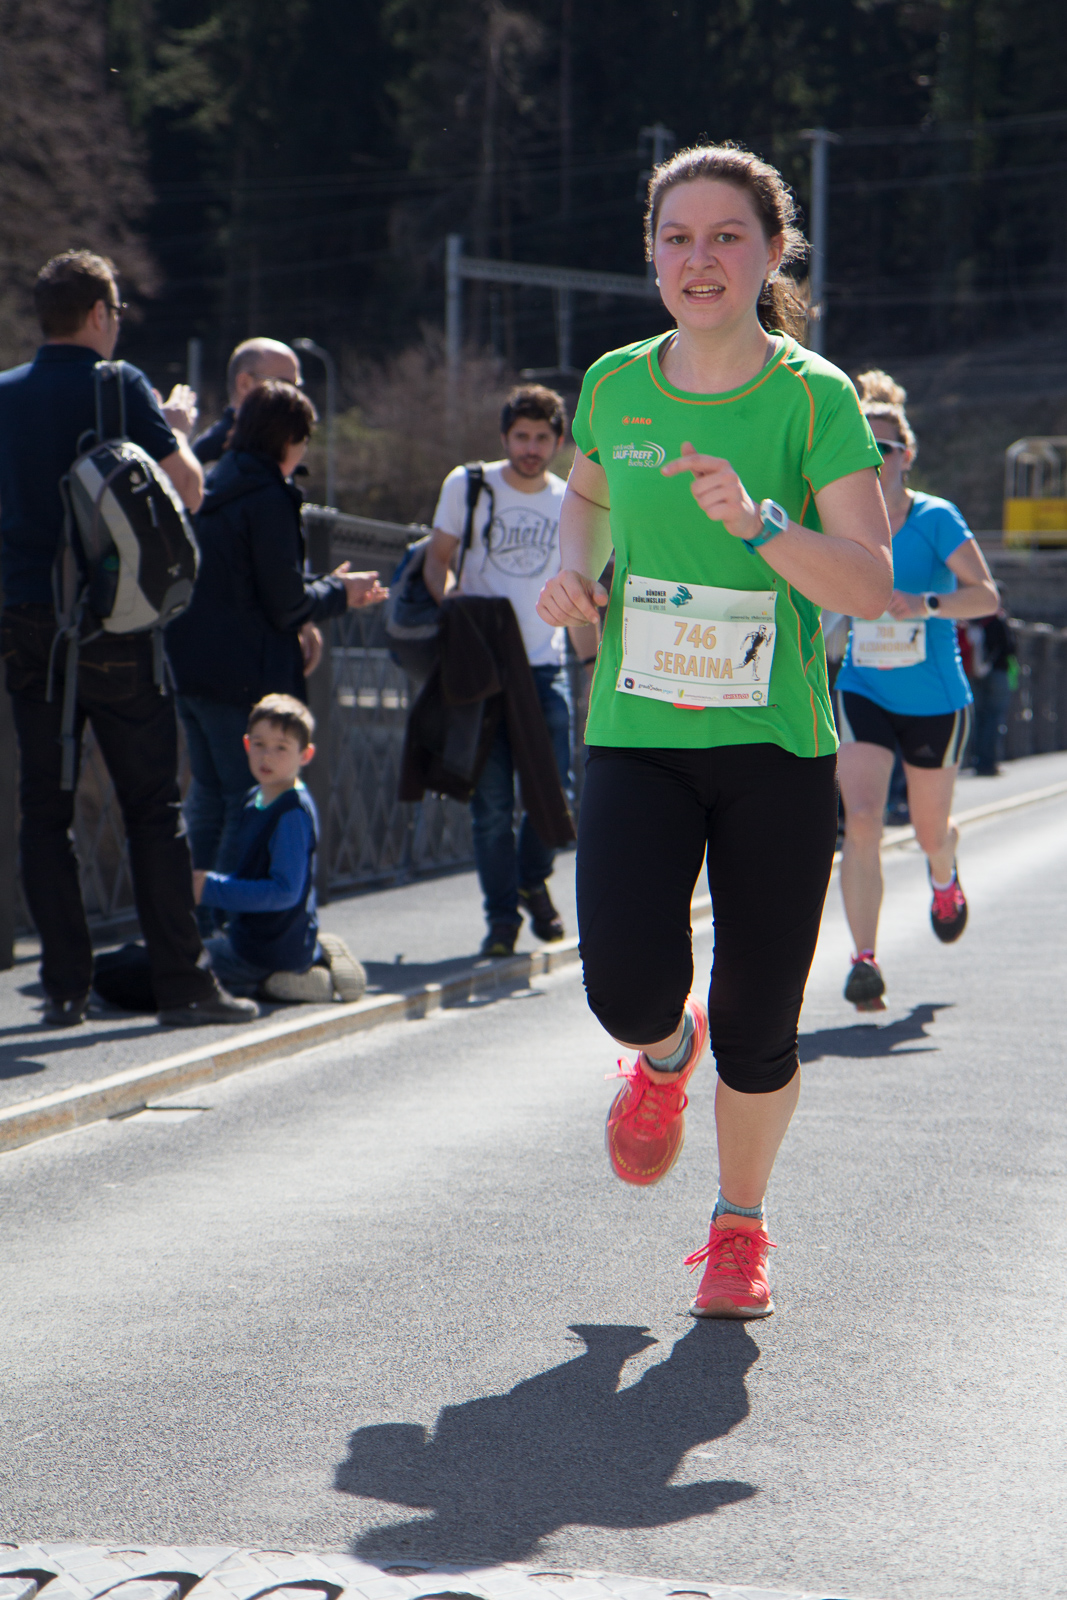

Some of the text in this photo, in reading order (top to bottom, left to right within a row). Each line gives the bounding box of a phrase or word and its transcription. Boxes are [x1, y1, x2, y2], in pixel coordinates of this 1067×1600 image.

[631, 417, 652, 425] JAKO
[613, 450, 653, 459] LAUF-TREFF
[646, 588, 667, 596] BÜNDNER
[633, 595, 667, 603] FRÜHLINGSLAUF
[673, 621, 717, 650] 746
[653, 650, 733, 679] SERAINA
